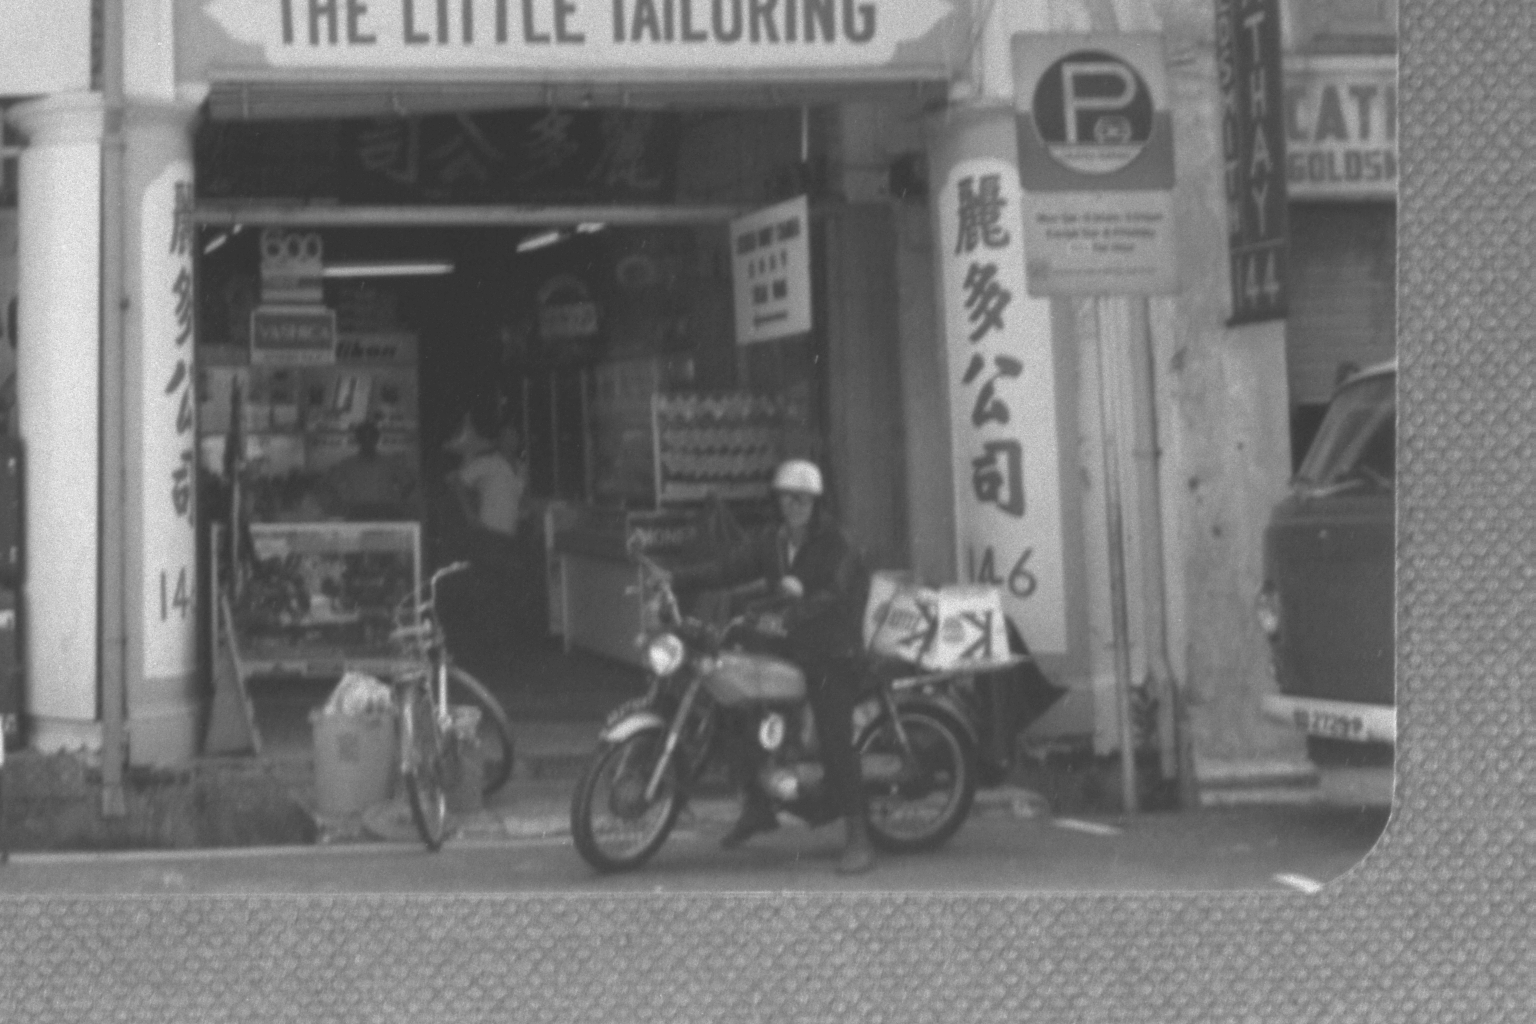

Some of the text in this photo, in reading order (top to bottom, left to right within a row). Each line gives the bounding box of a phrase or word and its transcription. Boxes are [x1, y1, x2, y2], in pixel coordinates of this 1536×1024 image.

[1062, 62, 1137, 143] P
[1233, 253, 1280, 311] 144
[954, 173, 1026, 519] 麗多公司
[968, 543, 1038, 598] 146
